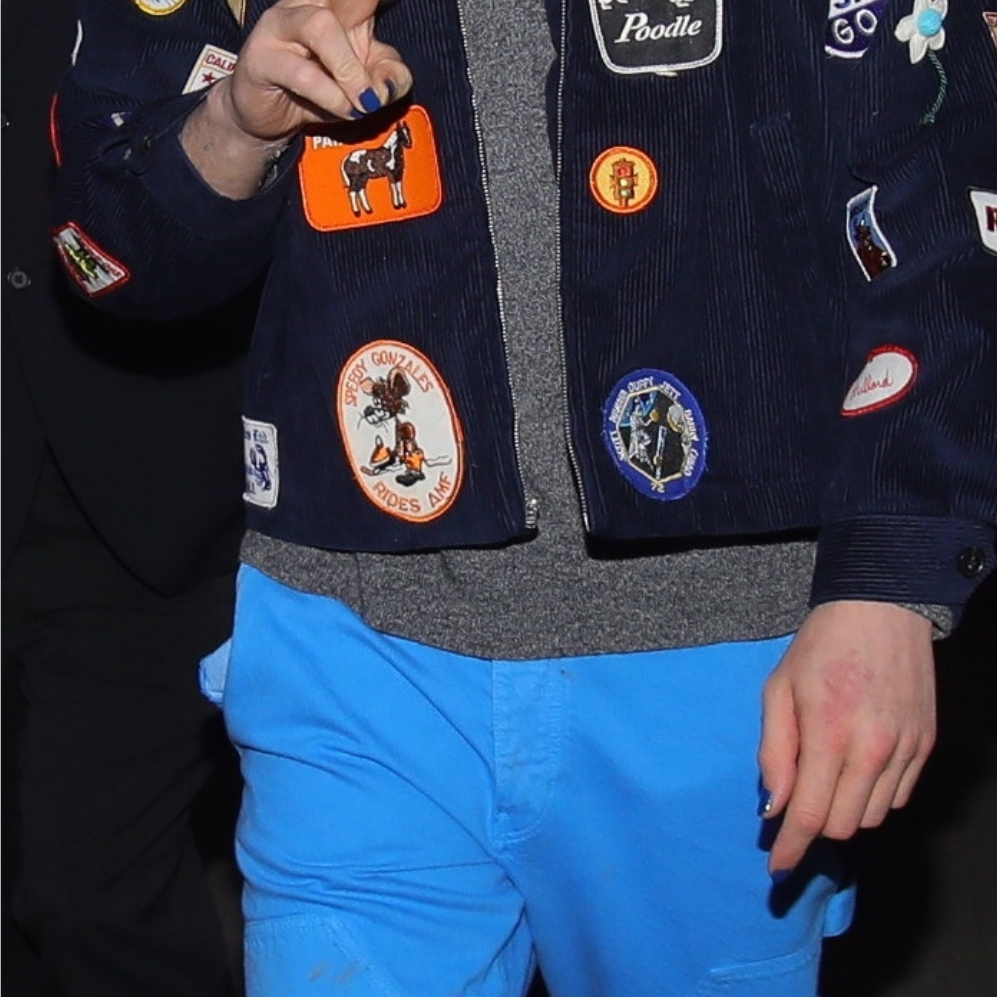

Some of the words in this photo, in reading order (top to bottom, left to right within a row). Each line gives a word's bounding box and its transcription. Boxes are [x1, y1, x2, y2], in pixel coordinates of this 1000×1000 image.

[614, 12, 702, 43] Poodle
[371, 351, 434, 393] GONZALES
[372, 481, 421, 513] RIDES
[428, 471, 451, 508] AMF
